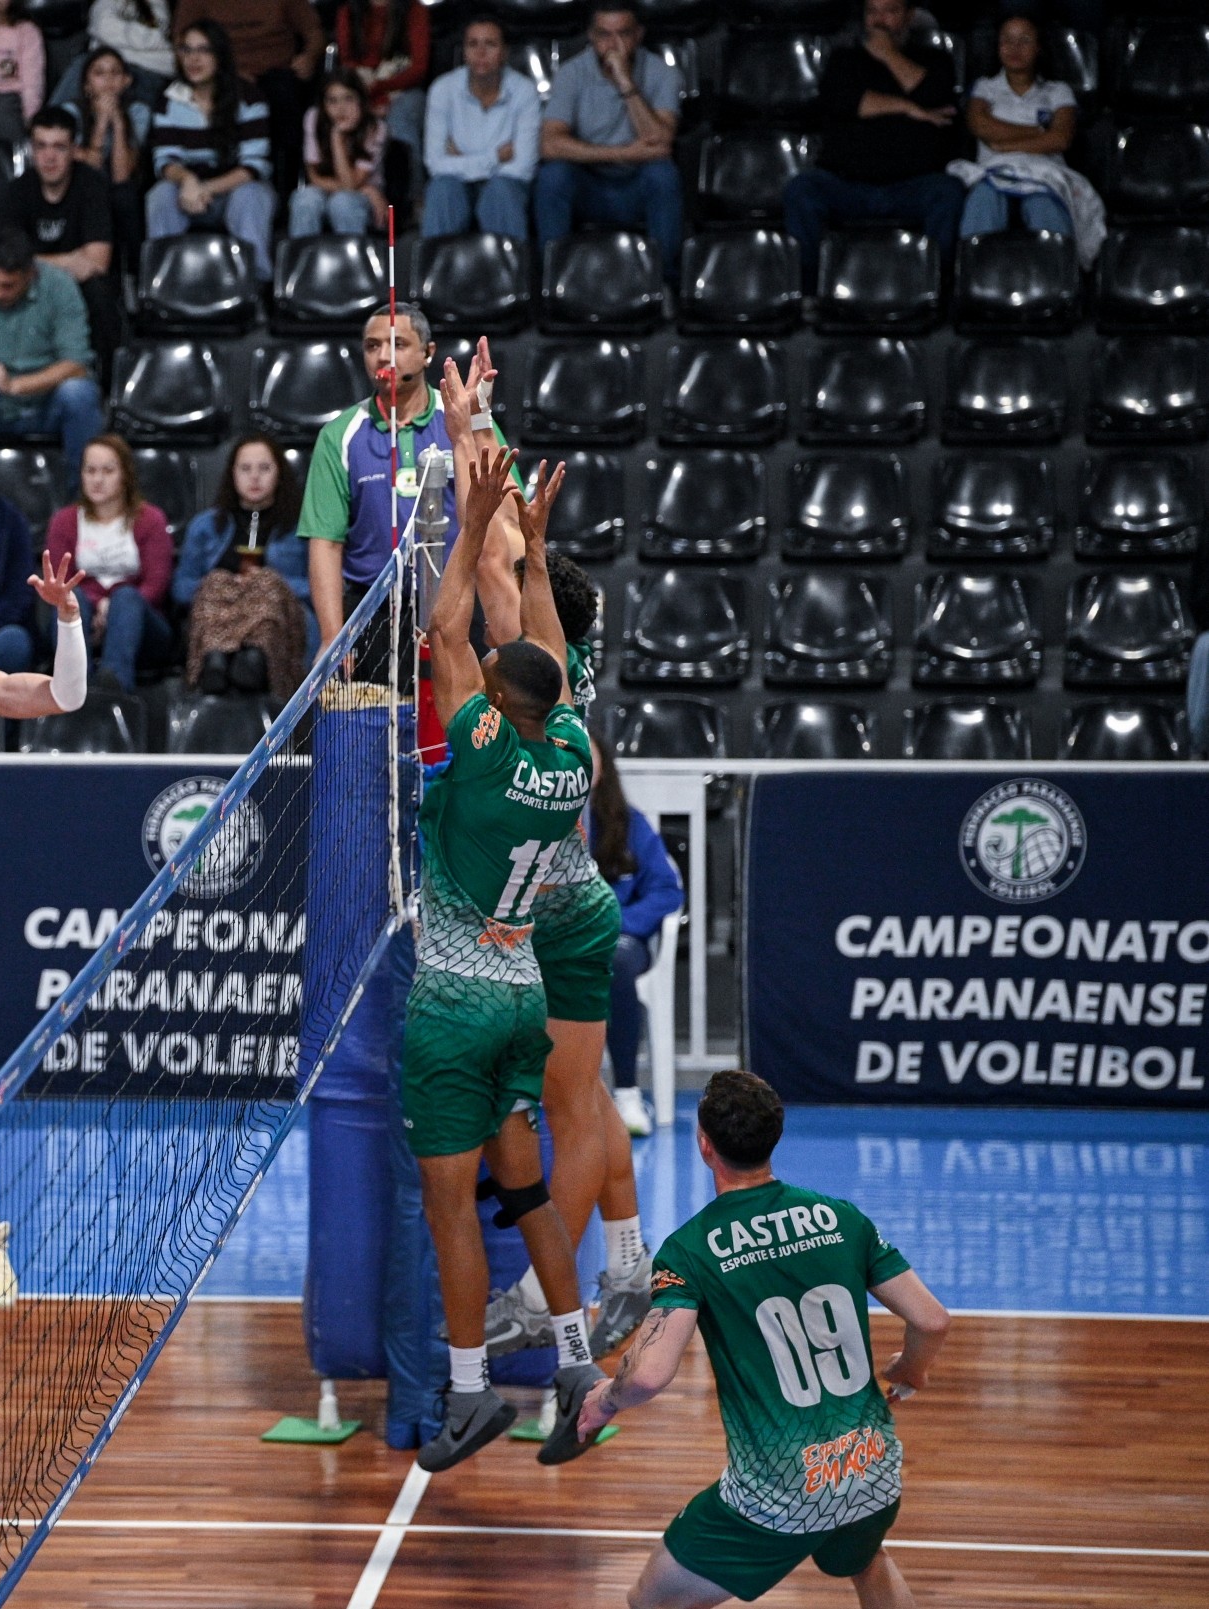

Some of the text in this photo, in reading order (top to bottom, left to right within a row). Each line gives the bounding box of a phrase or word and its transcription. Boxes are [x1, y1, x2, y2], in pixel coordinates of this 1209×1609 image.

[505, 788, 543, 809] ESPORTE
[512, 759, 590, 799] CASTRO
[493, 838, 563, 919] 11
[835, 914, 1209, 964] CAMPEONATO
[850, 976, 1207, 1026] PARANAENSE
[42, 1031, 300, 1077] DE VOLEIB
[855, 1040, 1206, 1090] DE VOLEIBOL
[706, 1203, 838, 1258] CASTRO
[720, 1231, 844, 1274] ESPORTE E JUVENTUDE
[563, 1323, 589, 1362] atleta
[755, 1283, 871, 1408] 09
[802, 1432, 862, 1467] ESPORTE
[804, 1426, 887, 1495] EM AÇÃO
